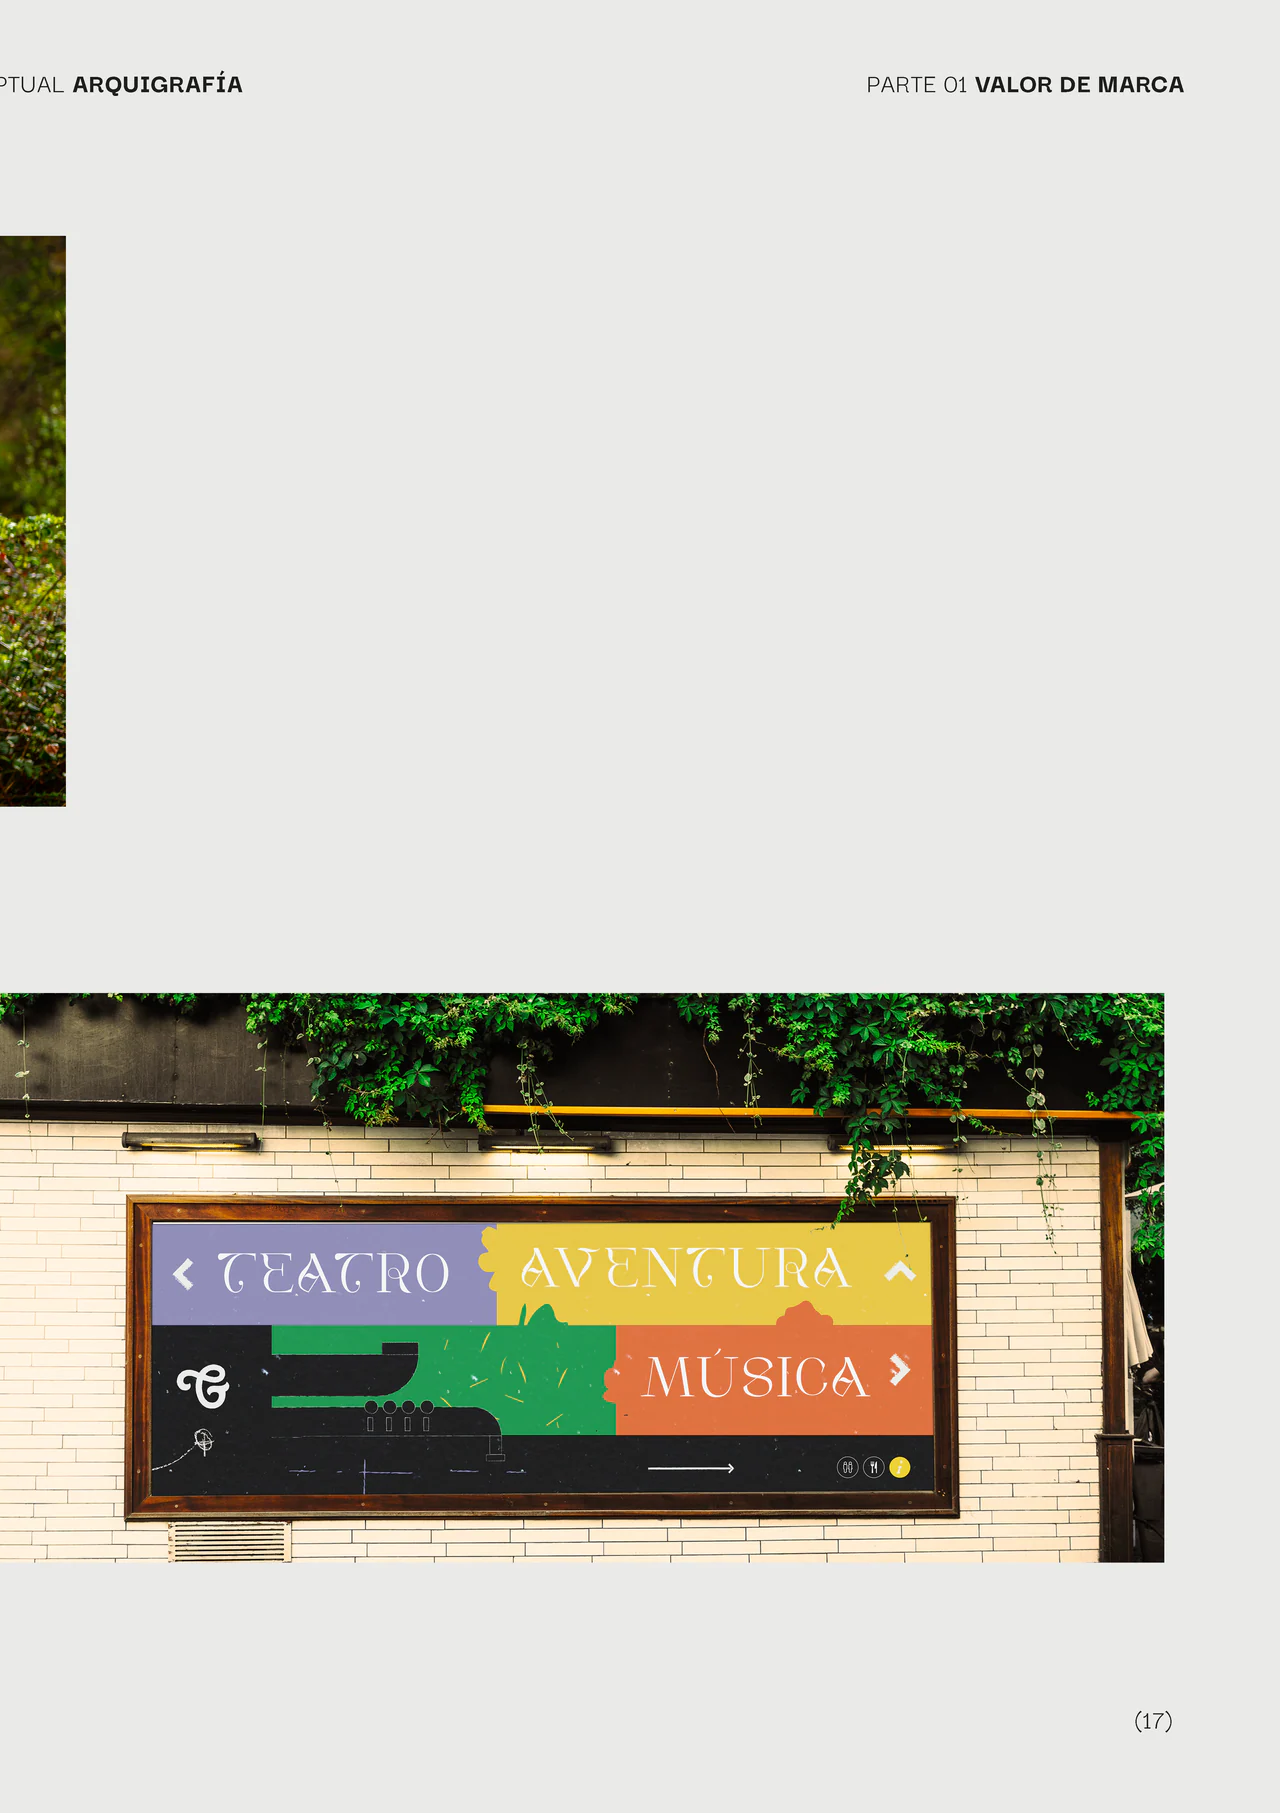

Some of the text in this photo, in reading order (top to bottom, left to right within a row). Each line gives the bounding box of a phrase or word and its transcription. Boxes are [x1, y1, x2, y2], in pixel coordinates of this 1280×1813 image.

[72, 70, 243, 96] ARQUIGRAFÍA
[867, 75, 1185, 94] PARTE 01 VALOR DE MARCA
[217, 1251, 450, 1295] TEATRO
[520, 1246, 853, 1289] AVENTURA
[640, 1347, 871, 1399] MÚSICA
[1134, 1710, 1173, 1734] (17)
